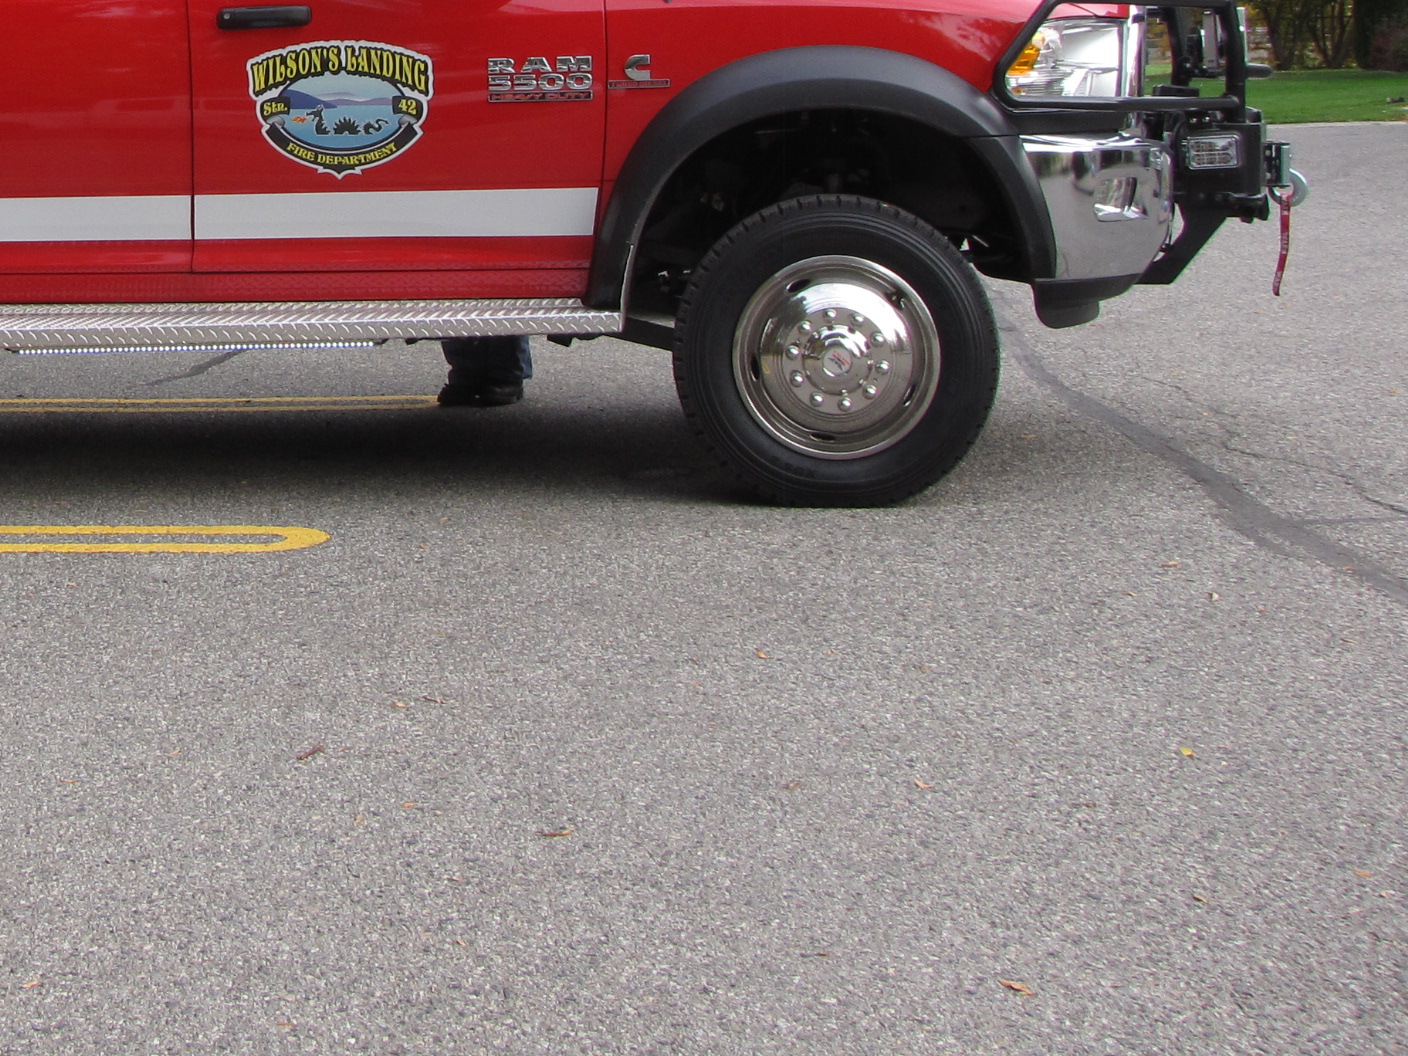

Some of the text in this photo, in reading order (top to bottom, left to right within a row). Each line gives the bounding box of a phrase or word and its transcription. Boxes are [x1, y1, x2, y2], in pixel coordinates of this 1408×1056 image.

[251, 45, 429, 93] WILSON'S LANDING
[488, 55, 593, 74] RAM
[488, 73, 593, 91] 5500
[398, 98, 417, 115] 42
[286, 142, 398, 165] FIRE DEPARTMENT
